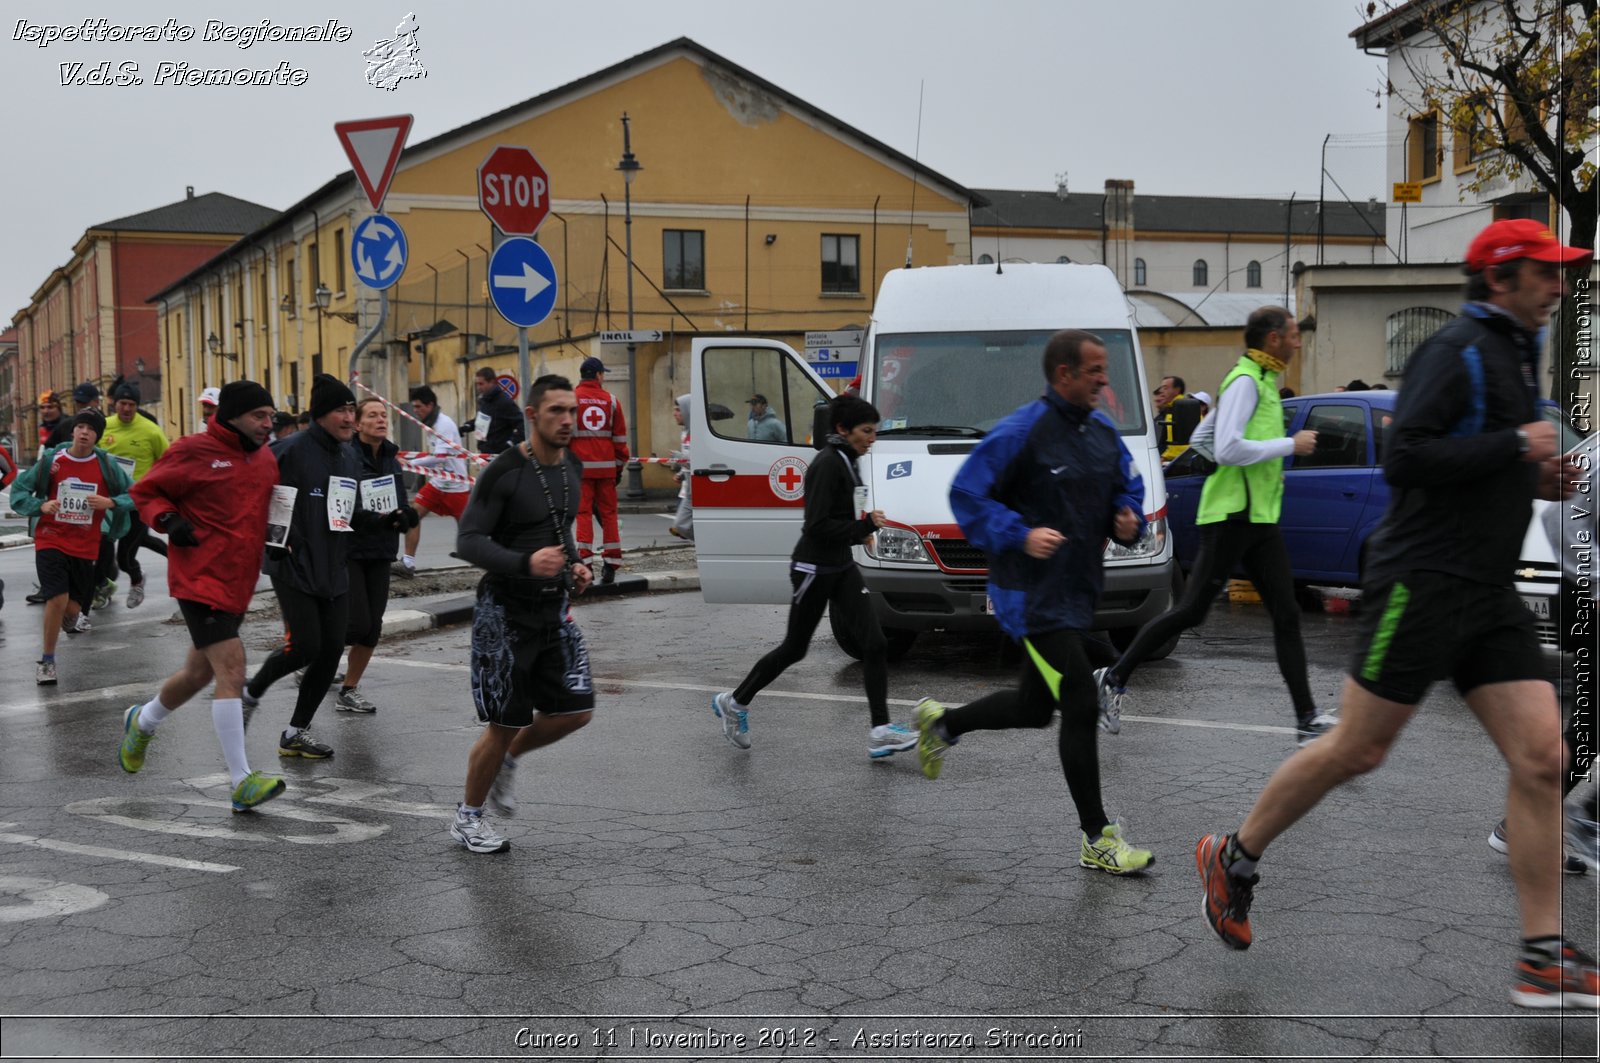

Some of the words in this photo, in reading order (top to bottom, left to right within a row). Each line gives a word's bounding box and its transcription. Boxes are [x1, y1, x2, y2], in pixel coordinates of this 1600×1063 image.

[485, 173, 546, 208] STOP
[63, 497, 88, 510] 6606
[370, 495, 392, 512] 9611
